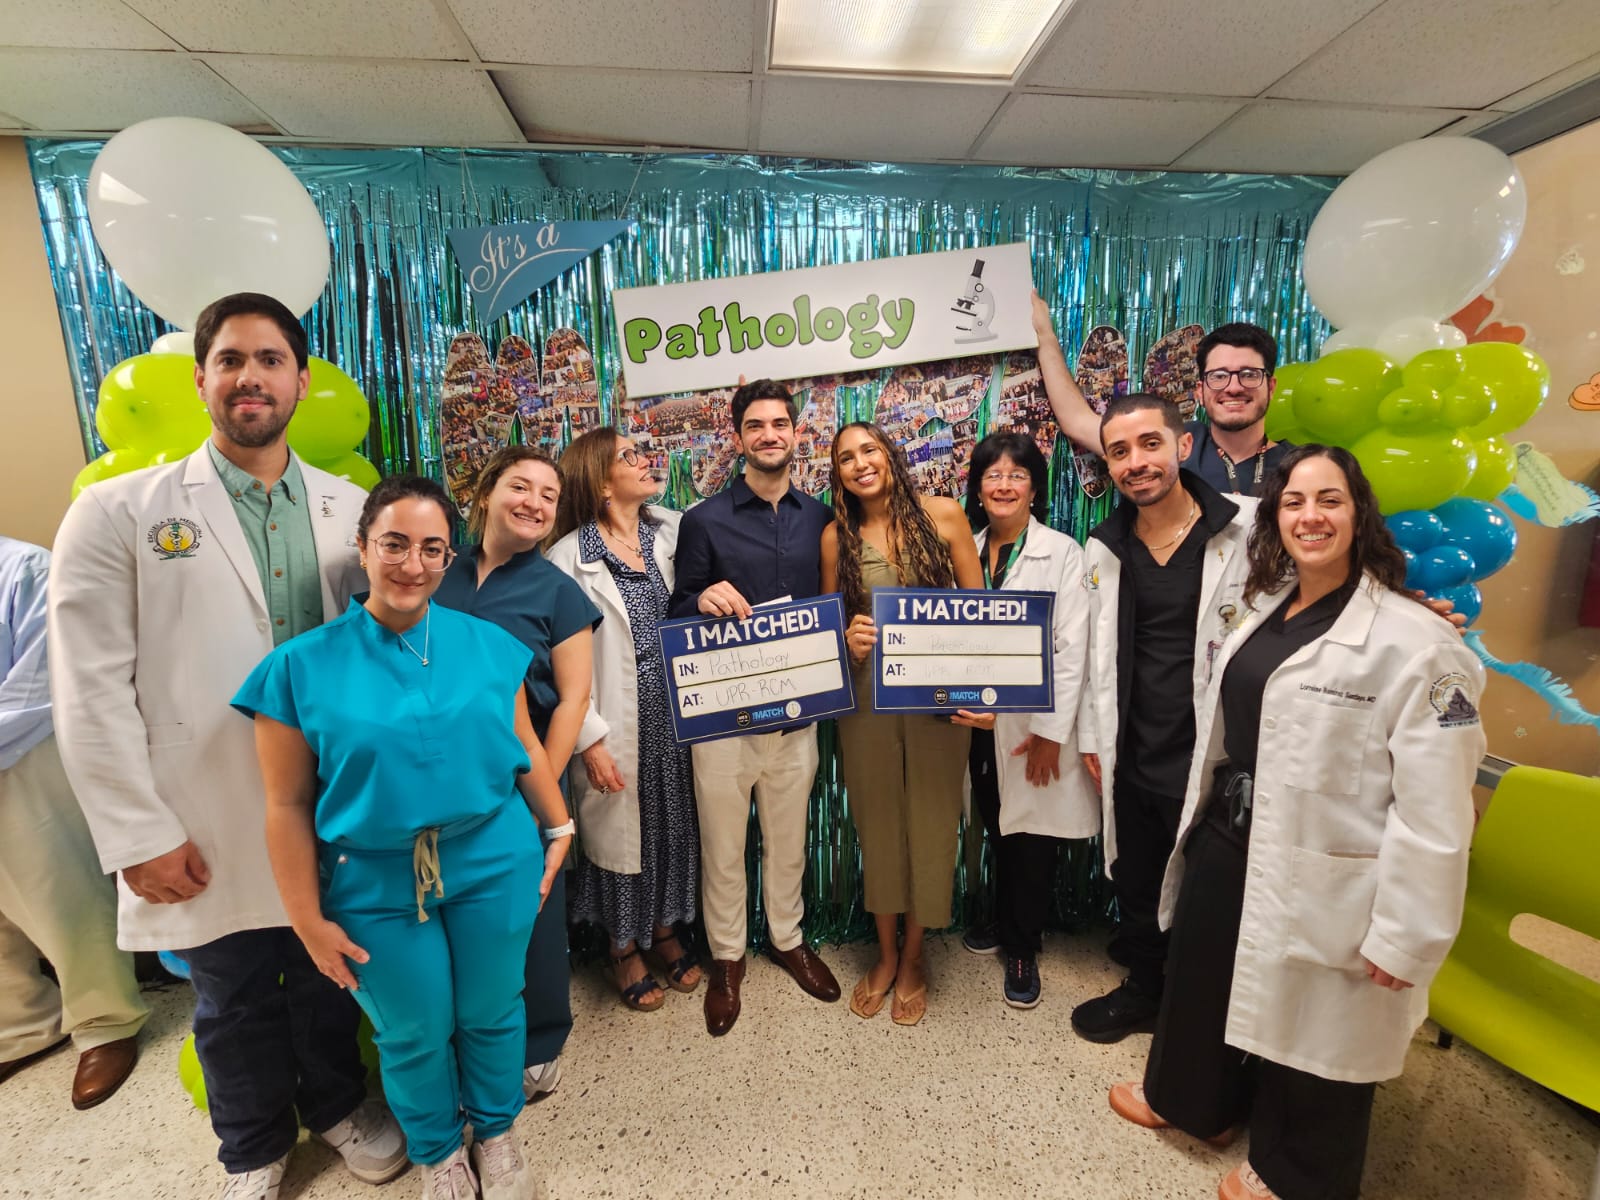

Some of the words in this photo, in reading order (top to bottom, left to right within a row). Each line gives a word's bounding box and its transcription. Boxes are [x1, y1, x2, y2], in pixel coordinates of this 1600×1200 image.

[470, 230, 527, 293] It's
[536, 223, 560, 249] a
[624, 293, 916, 364] Pathology
[898, 598, 907, 620] I
[912, 598, 1028, 621] MATCHED!
[685, 627, 695, 650] I
[699, 607, 820, 648] MATCHED!
[887, 632, 906, 645] IN:
[678, 662, 699, 677] IN:
[706, 648, 790, 678] Pathology
[885, 663, 906, 677] AT:
[682, 693, 704, 708] AT:
[952, 691, 979, 700] MATCH
[755, 706, 784, 720] MATCH
